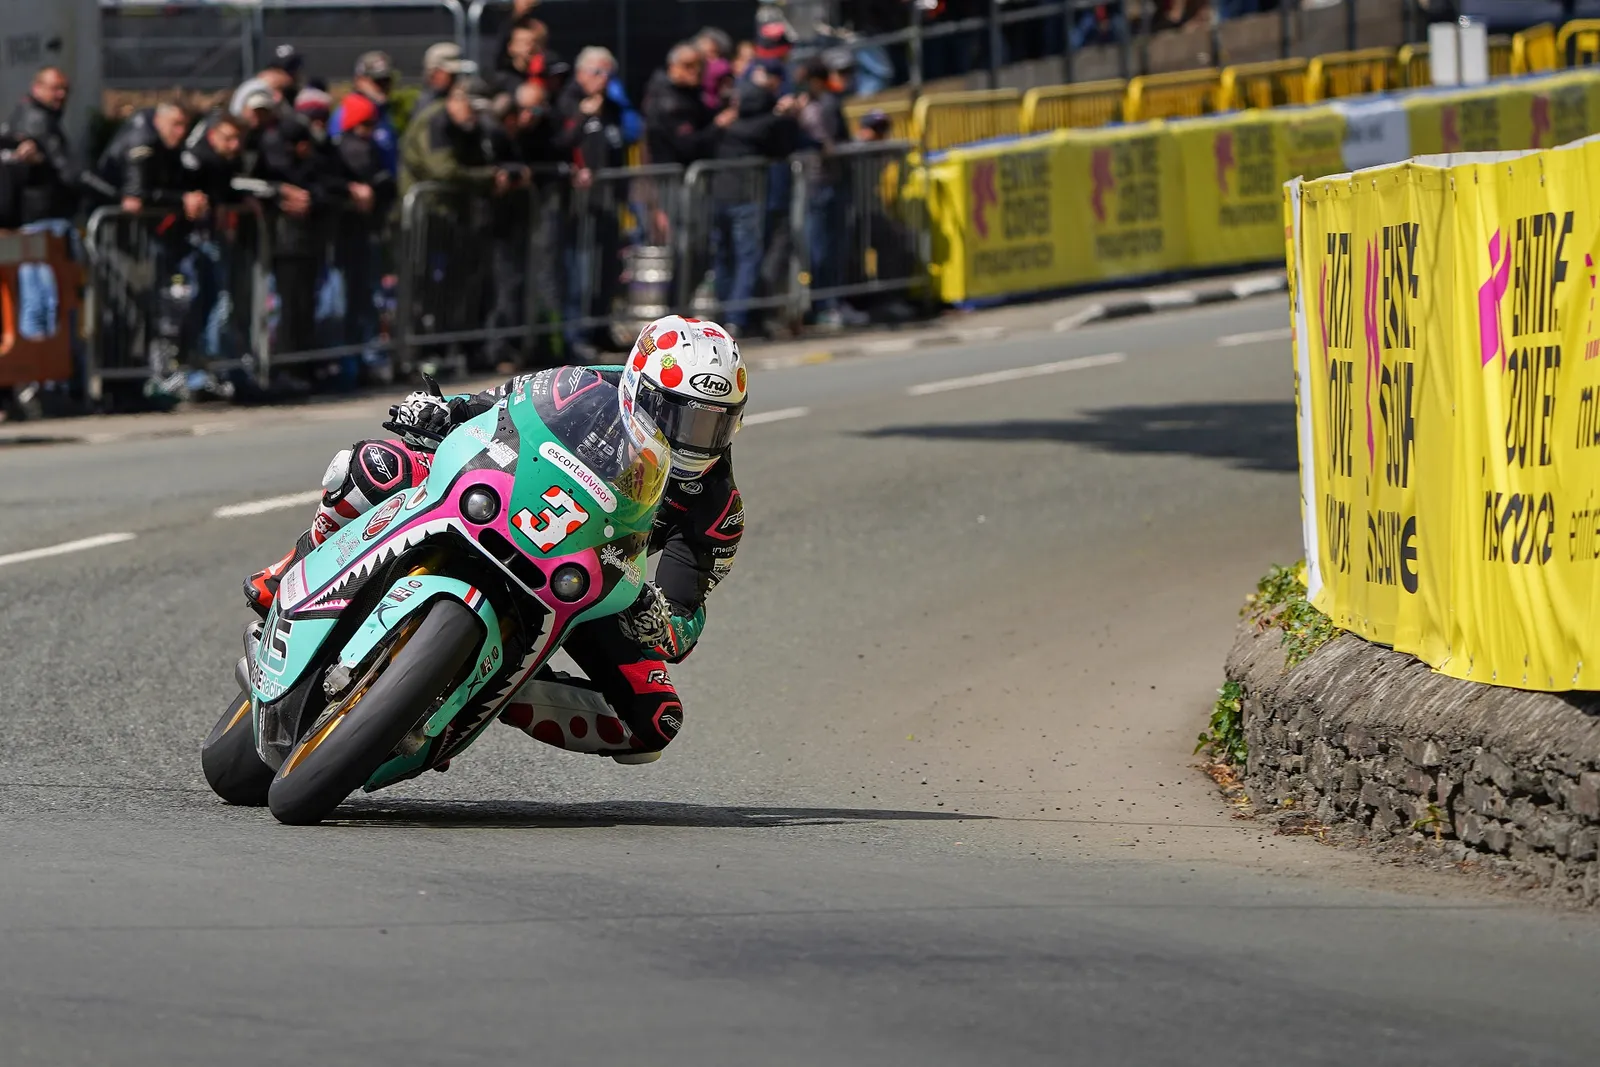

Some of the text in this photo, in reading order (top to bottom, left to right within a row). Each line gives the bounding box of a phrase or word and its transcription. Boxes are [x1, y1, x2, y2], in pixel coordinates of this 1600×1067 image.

[692, 375, 729, 393] Arai
[587, 431, 616, 456] STB
[367, 445, 393, 480] RST
[547, 447, 611, 504] escortadvisor
[511, 485, 589, 553] 3
